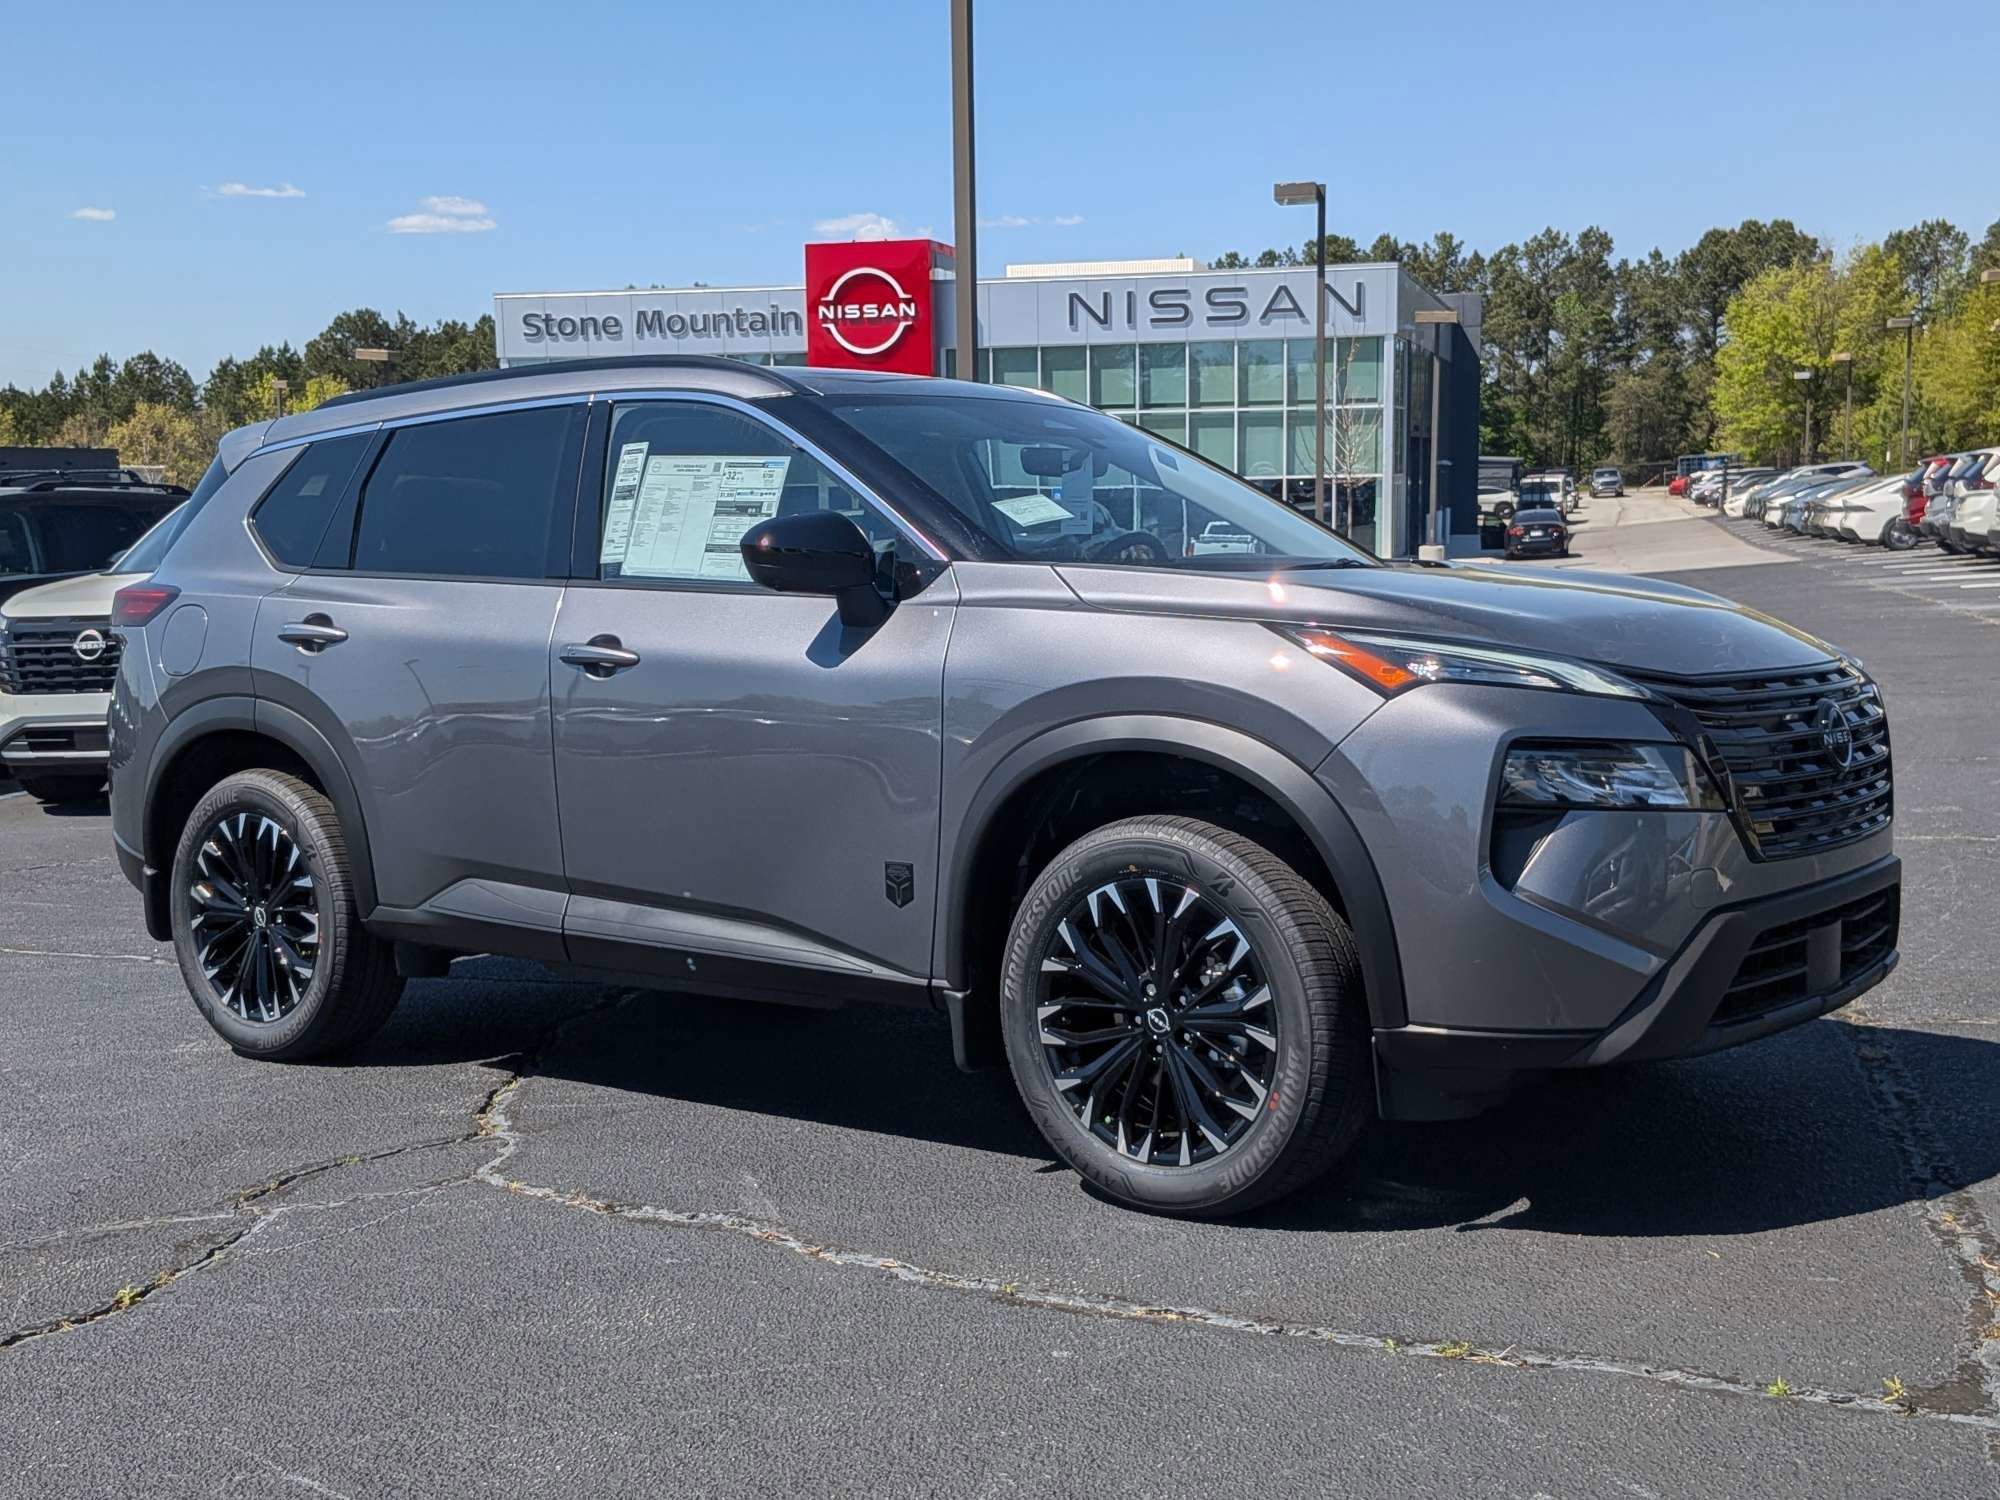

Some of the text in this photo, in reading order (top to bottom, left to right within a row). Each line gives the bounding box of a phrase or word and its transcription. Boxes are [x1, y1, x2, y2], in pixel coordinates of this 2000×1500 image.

[522, 305, 801, 338] Stone Mountain
[818, 302, 916, 319] NISSAN
[1069, 282, 1362, 326] NISSAN
[1004, 861, 1082, 1000] BRIDGESTONE
[1218, 1045, 1300, 1194] BRIDGESTONE
